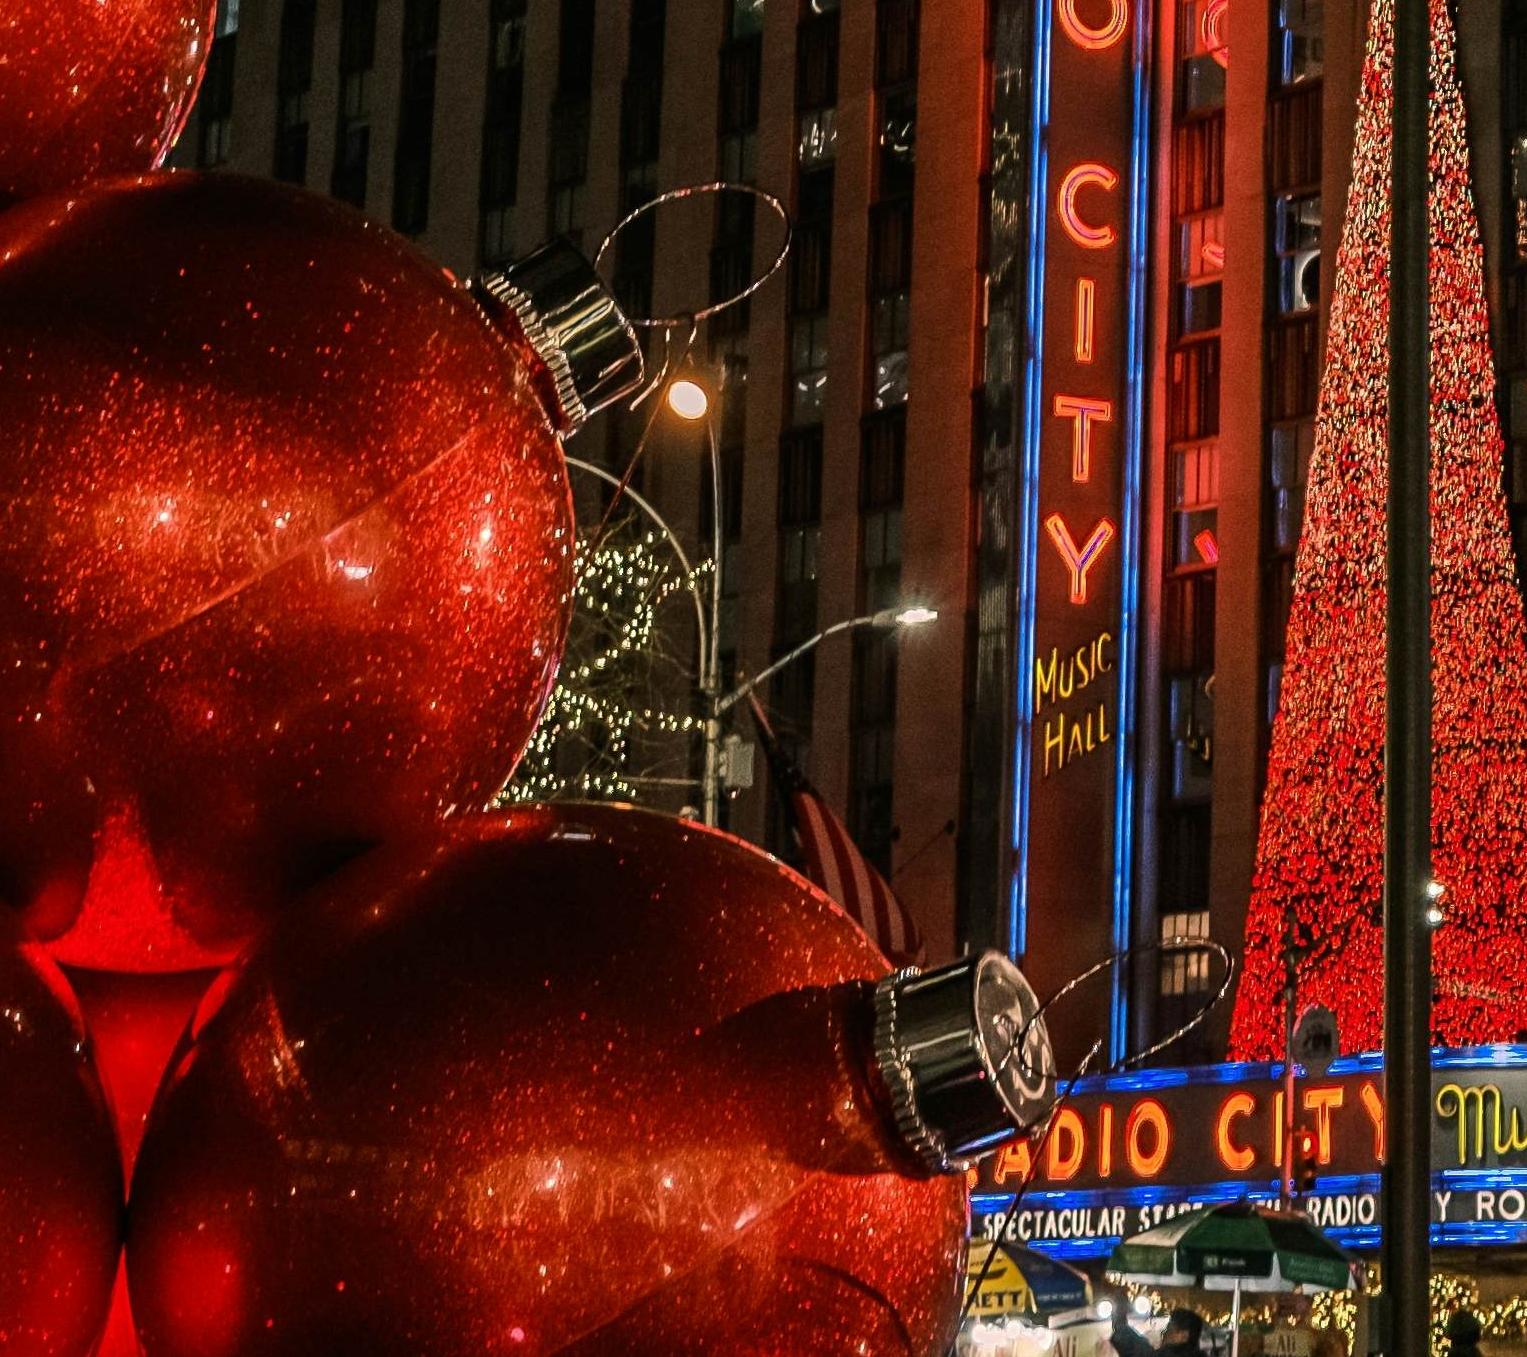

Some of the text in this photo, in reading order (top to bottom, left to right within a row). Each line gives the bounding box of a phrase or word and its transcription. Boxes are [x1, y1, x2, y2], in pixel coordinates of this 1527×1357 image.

[1044, 162, 1119, 606] CITY
[967, 1097, 1171, 1189] ADIO
[1216, 1082, 1386, 1172] CITY
[982, 1205, 1125, 1242] SPECTACULAR
